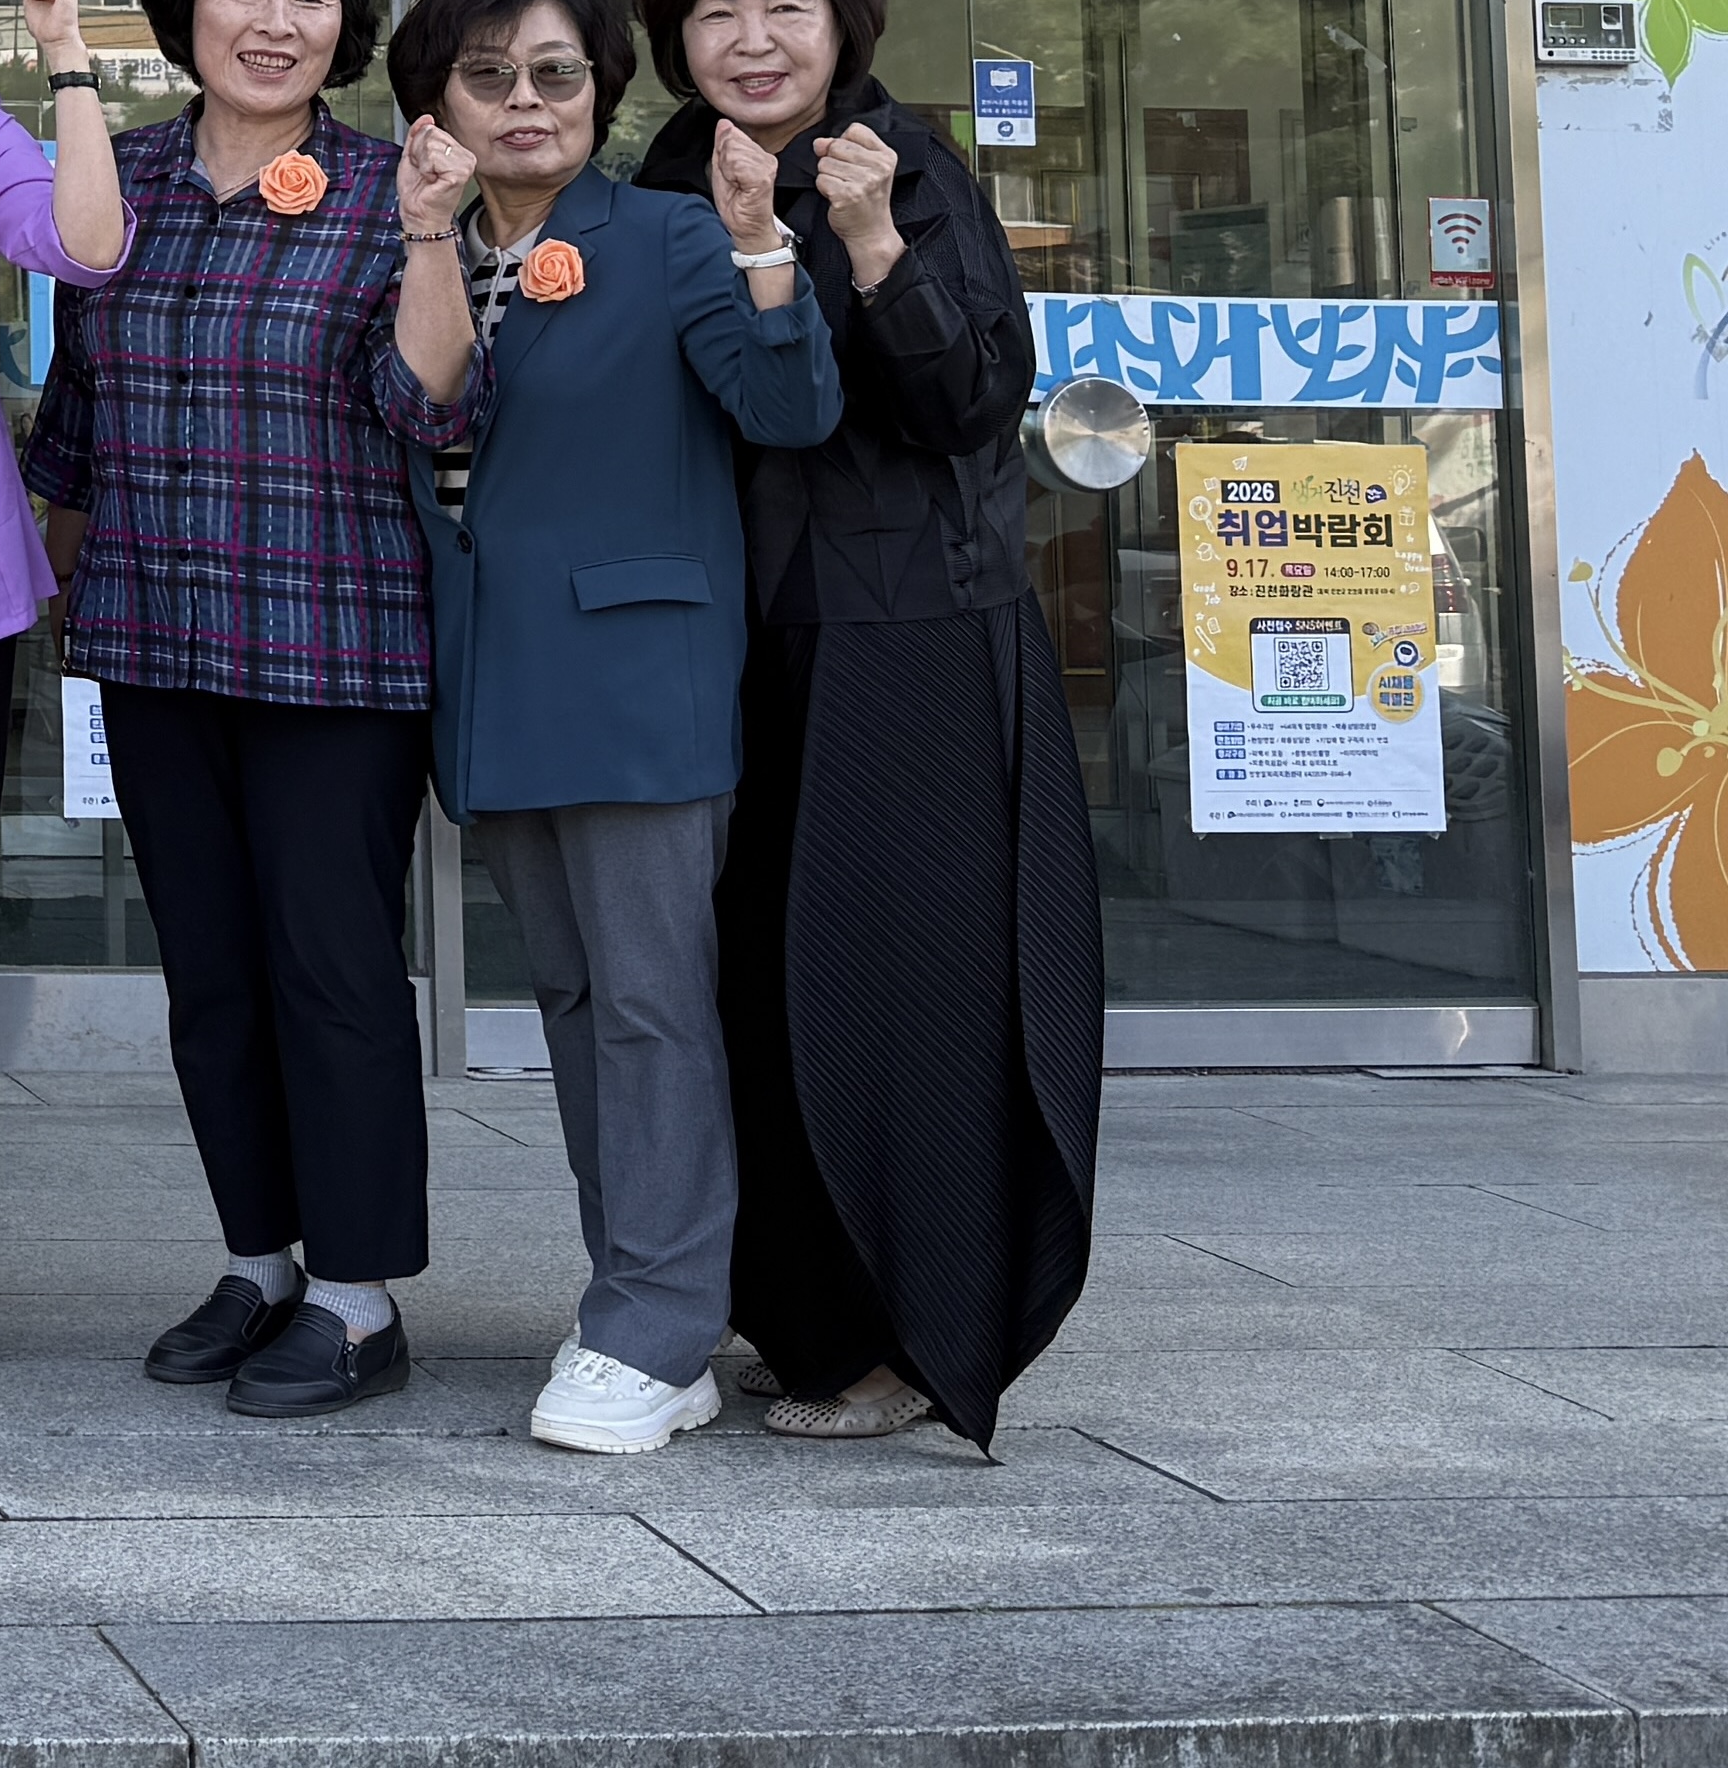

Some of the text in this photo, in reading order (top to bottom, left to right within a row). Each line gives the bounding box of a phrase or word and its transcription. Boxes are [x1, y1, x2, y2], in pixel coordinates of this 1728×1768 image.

[1226, 482, 1275, 502] 2026
[1216, 508, 1393, 548] 취업박람회
[1225, 558, 1275, 578] 9.17.
